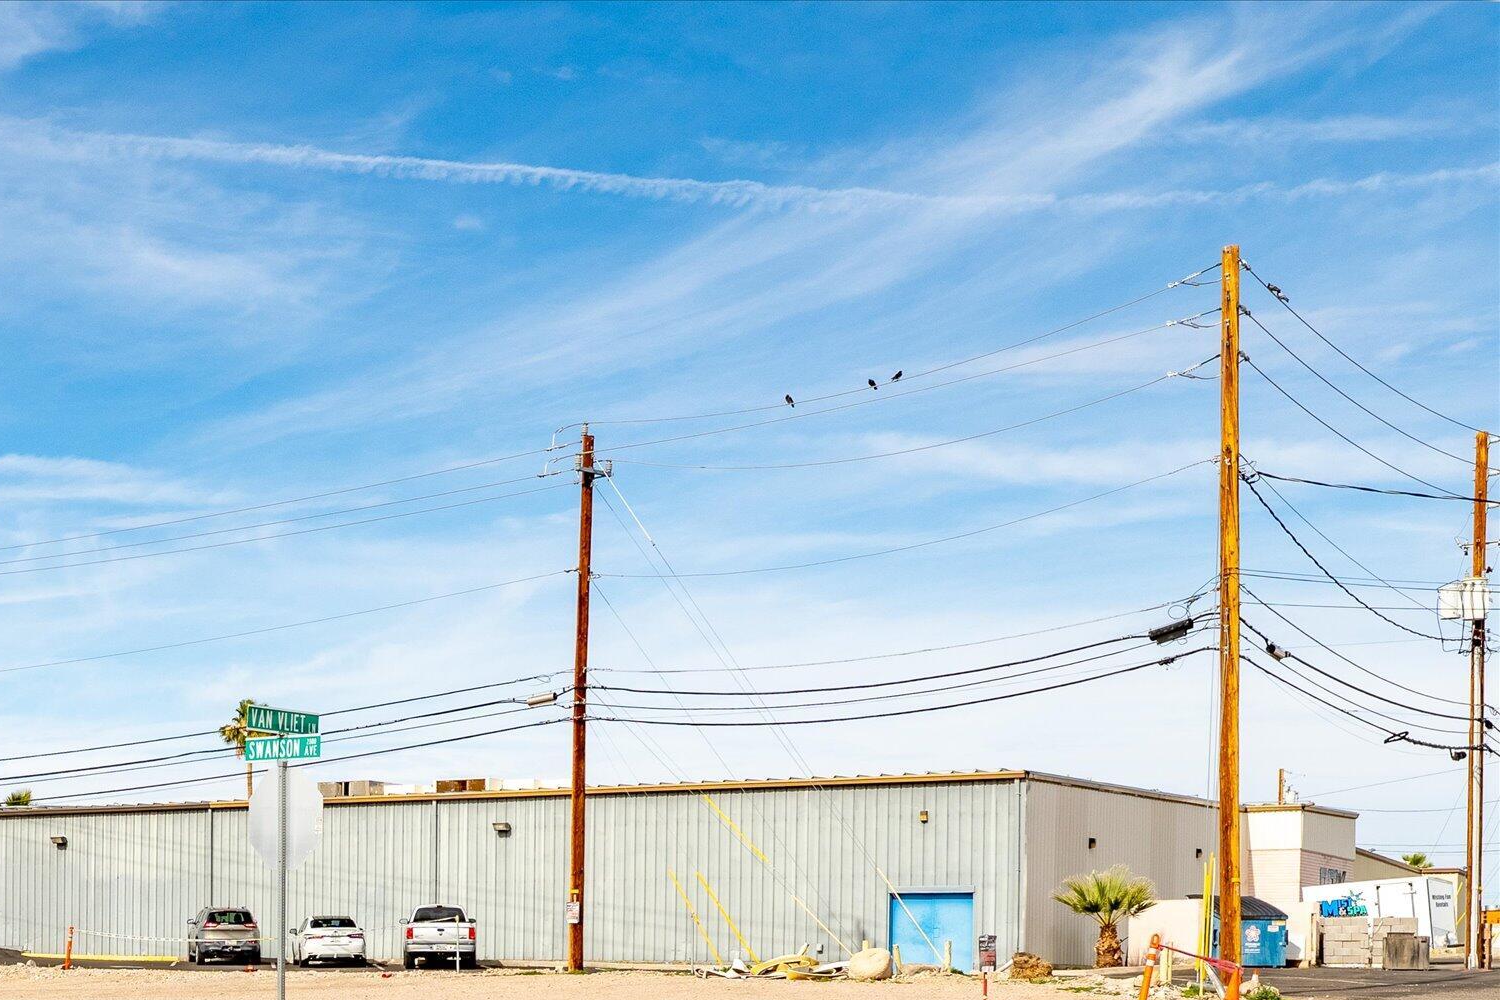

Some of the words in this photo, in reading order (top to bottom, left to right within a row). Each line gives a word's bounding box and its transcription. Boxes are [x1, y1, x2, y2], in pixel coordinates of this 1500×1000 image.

[251, 708, 273, 729] VAN
[277, 712, 306, 733] VLIET
[248, 738, 300, 759] SWANSON
[304, 745, 318, 756] AVE
